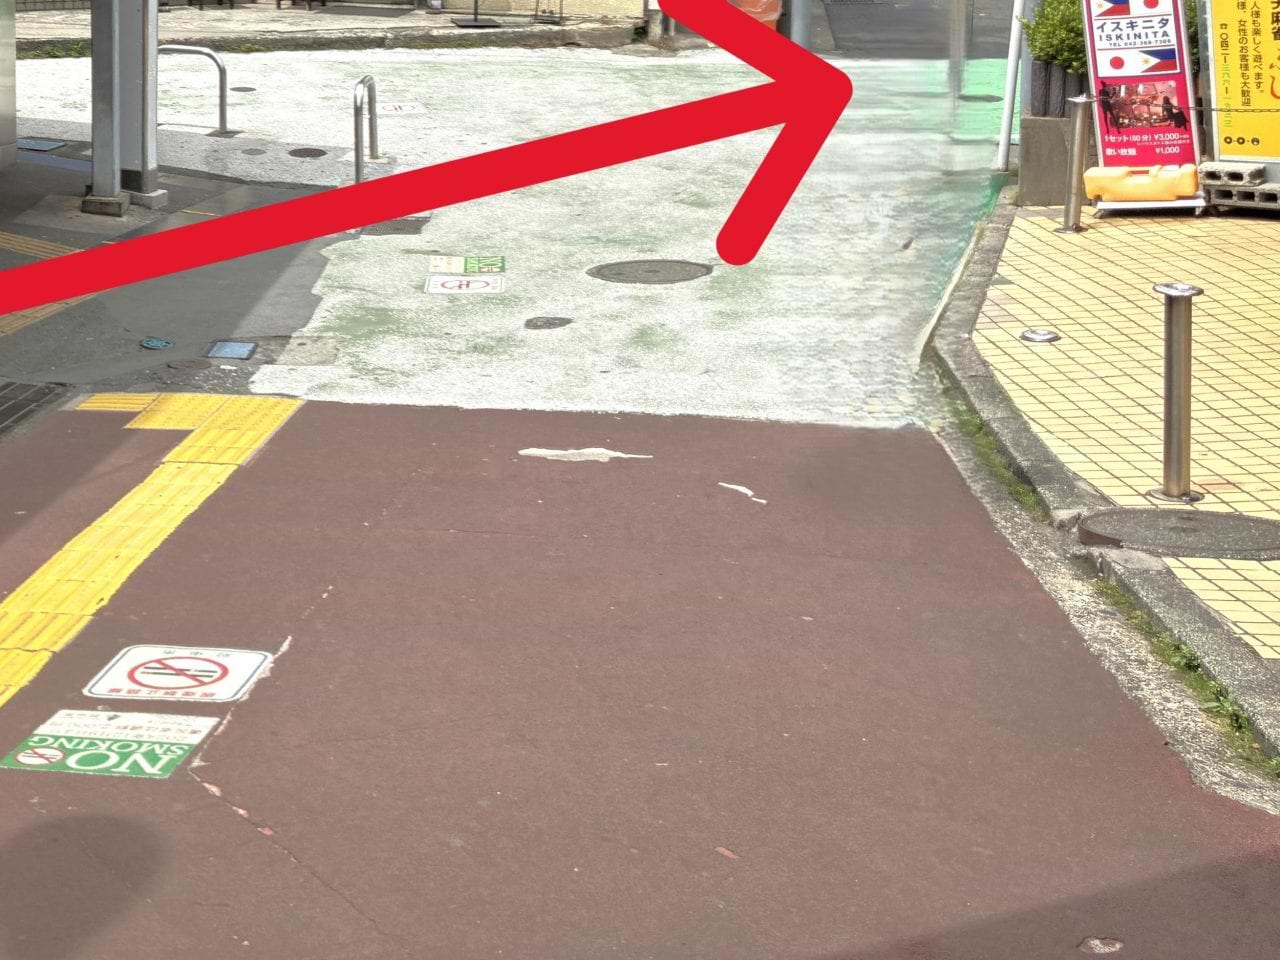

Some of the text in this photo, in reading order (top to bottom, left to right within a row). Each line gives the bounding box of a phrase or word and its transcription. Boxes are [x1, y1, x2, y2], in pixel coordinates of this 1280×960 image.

[1096, 17, 1169, 33] イスキニタ
[1099, 30, 1169, 41] ISKINITA
[29, 735, 189, 756] SMOKING
[65, 749, 177, 775] NO
